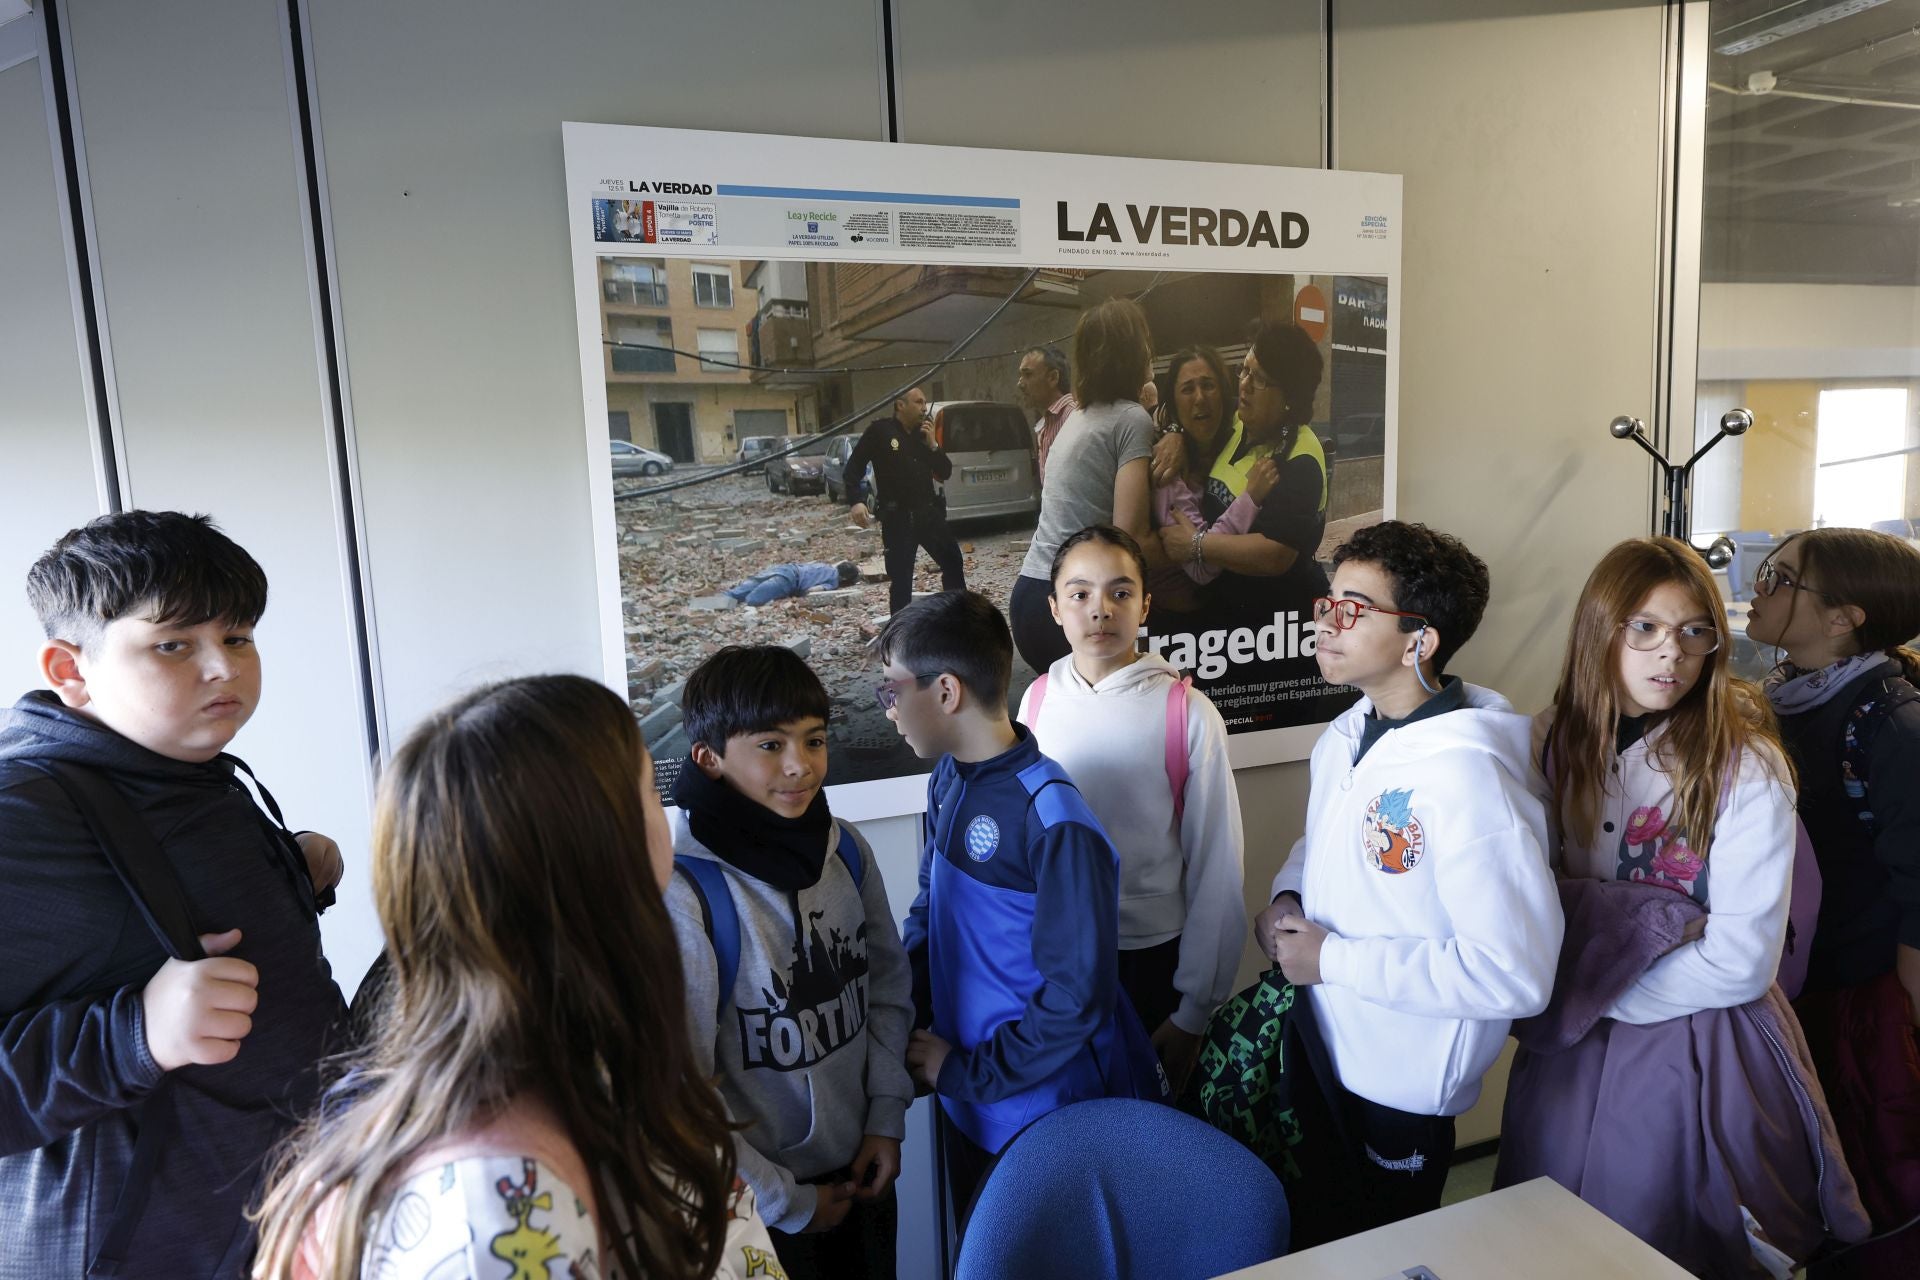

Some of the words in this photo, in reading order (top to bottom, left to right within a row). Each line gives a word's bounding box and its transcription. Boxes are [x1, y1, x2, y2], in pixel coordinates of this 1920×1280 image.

[629, 180, 651, 193] LA
[652, 181, 713, 196] VERDAD
[658, 203, 679, 212] Vajilla
[788, 211, 801, 220] Lea
[803, 213, 808, 221] y
[809, 211, 837, 221] Recicle
[1057, 200, 1122, 243] LA
[1126, 204, 1310, 249] VERDAD
[1211, 683, 1247, 696] heridos
[1247, 682, 1268, 696] muy
[1268, 679, 1299, 693] graves
[1300, 677, 1312, 686] en
[1223, 691, 1276, 709] registrados
[1276, 691, 1289, 701] en
[1289, 687, 1322, 701] España
[1322, 684, 1349, 696] desde
[1225, 716, 1254, 726] SPECIAL
